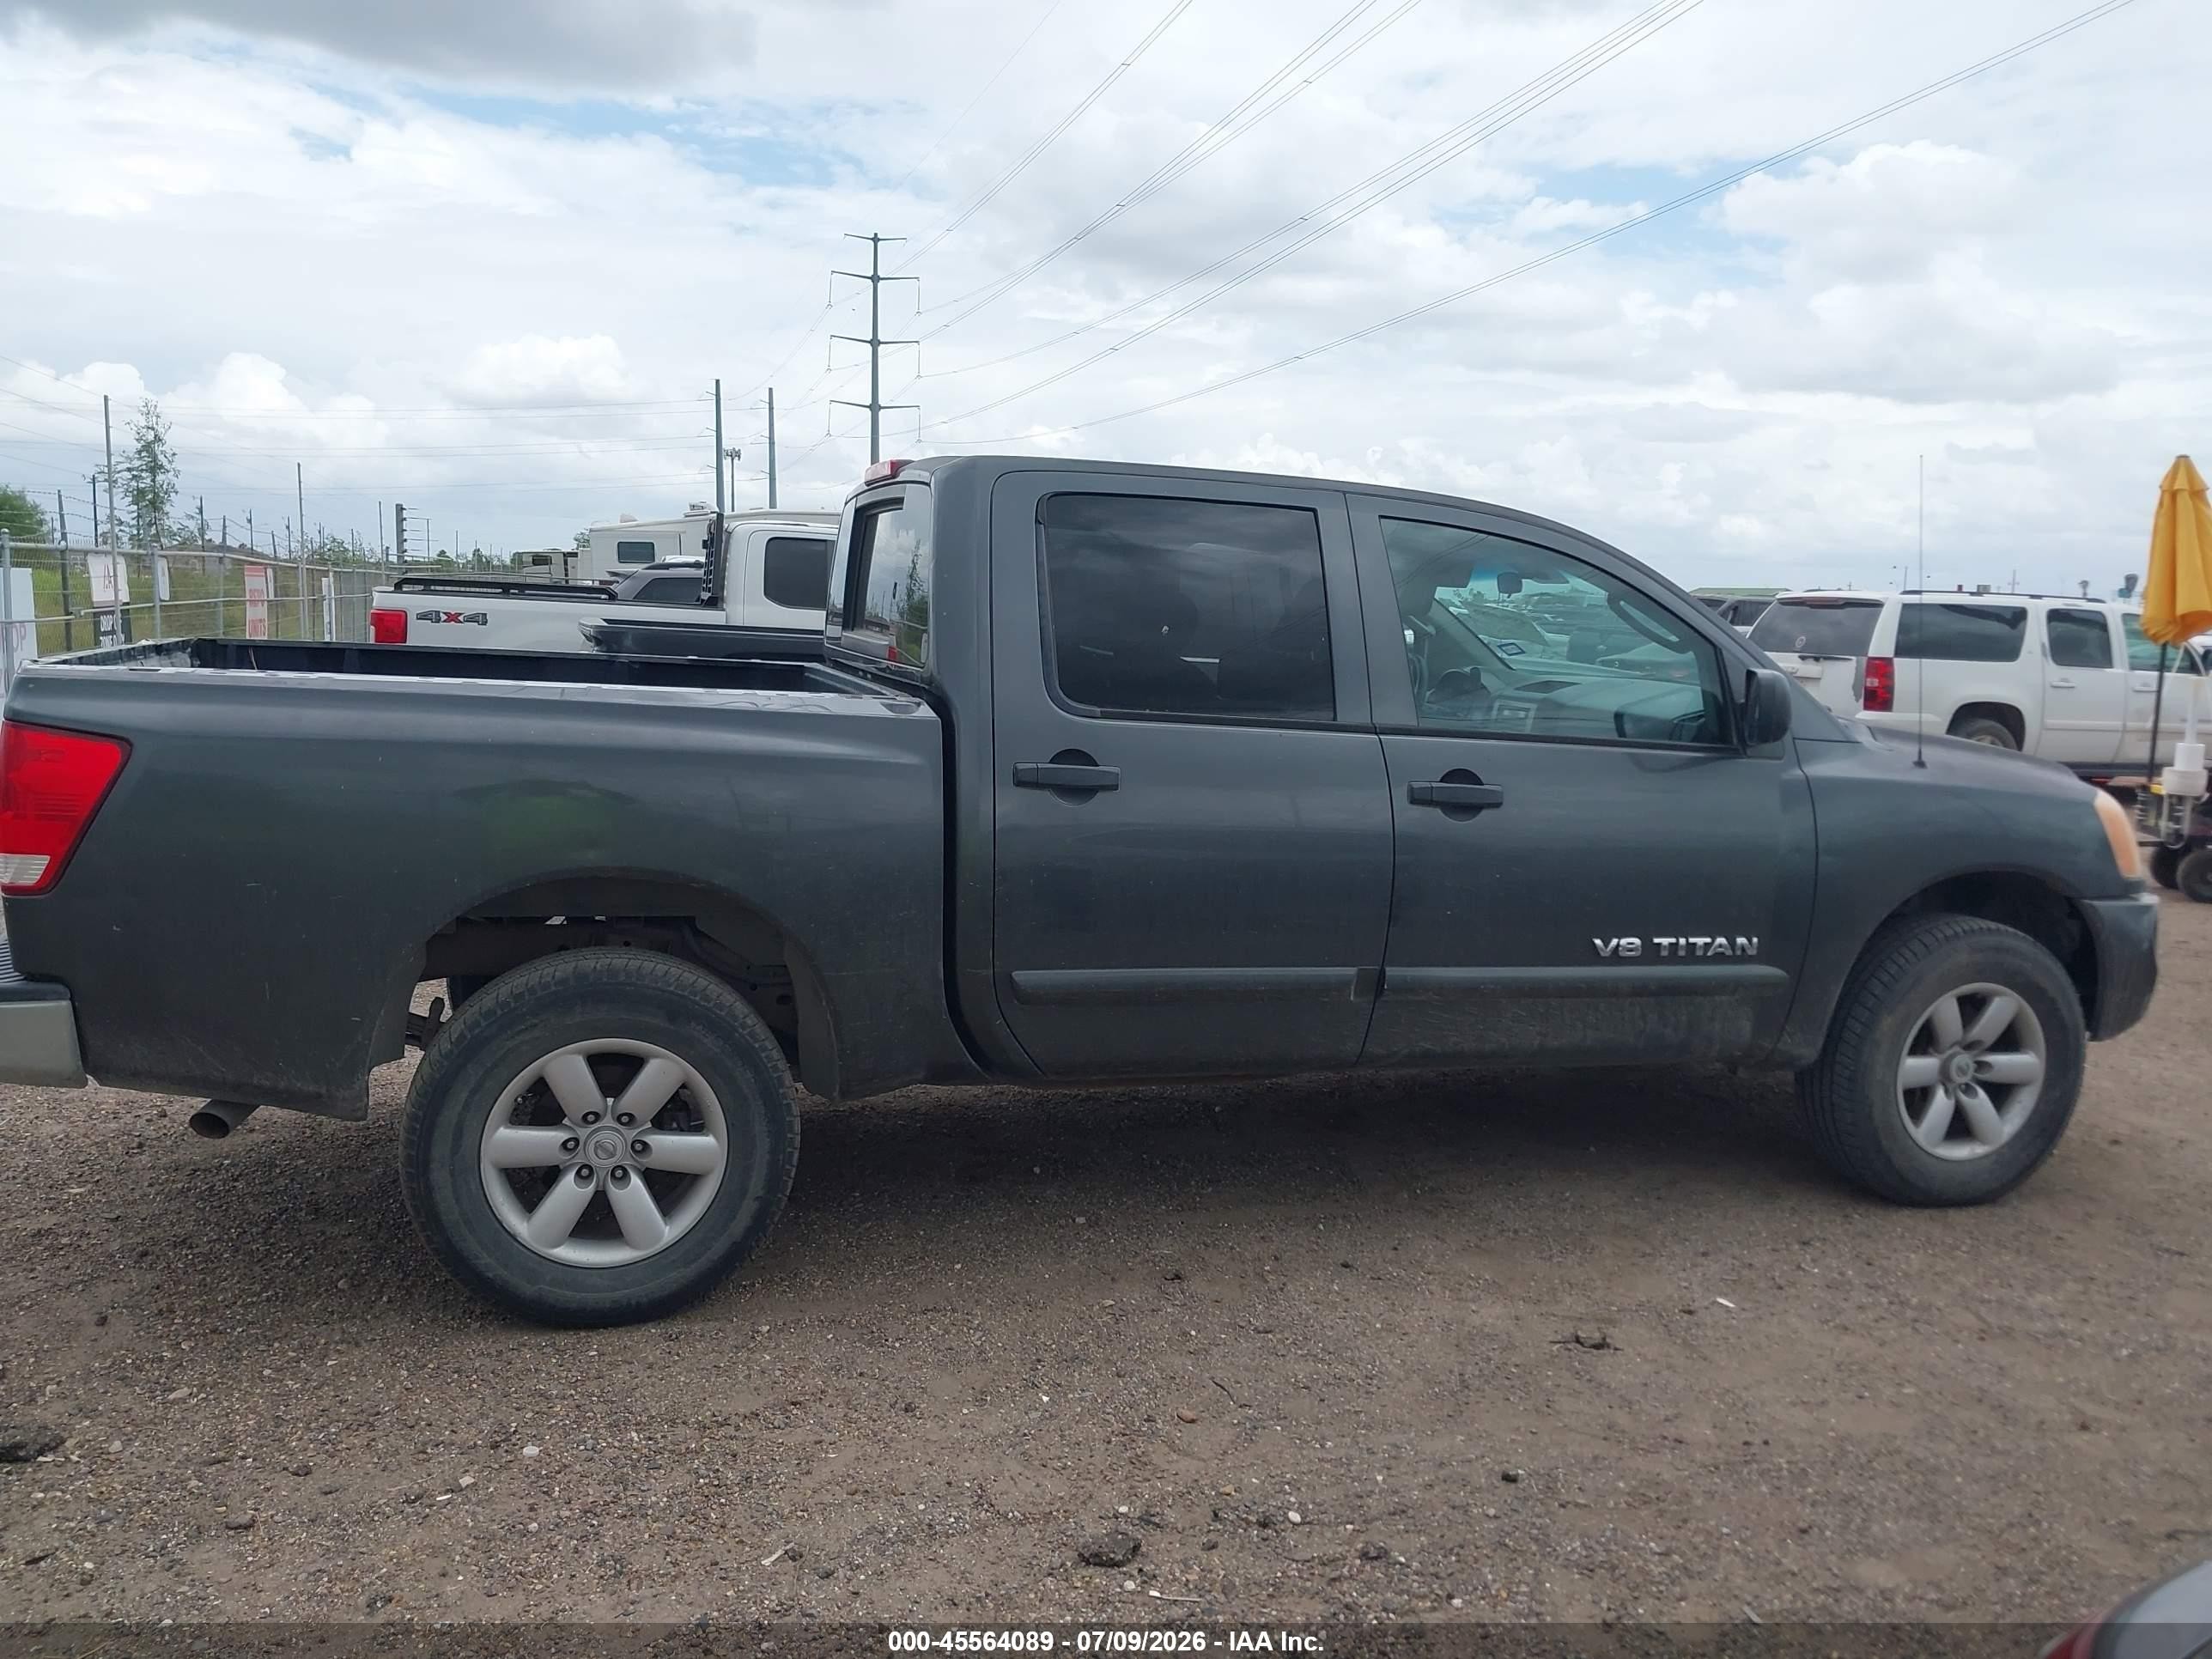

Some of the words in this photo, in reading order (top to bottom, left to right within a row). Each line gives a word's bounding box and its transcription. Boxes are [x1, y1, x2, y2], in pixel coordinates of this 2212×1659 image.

[100, 613, 113, 632] DROP
[1592, 937, 1642, 957] V8
[1653, 936, 1759, 957] TITAN
